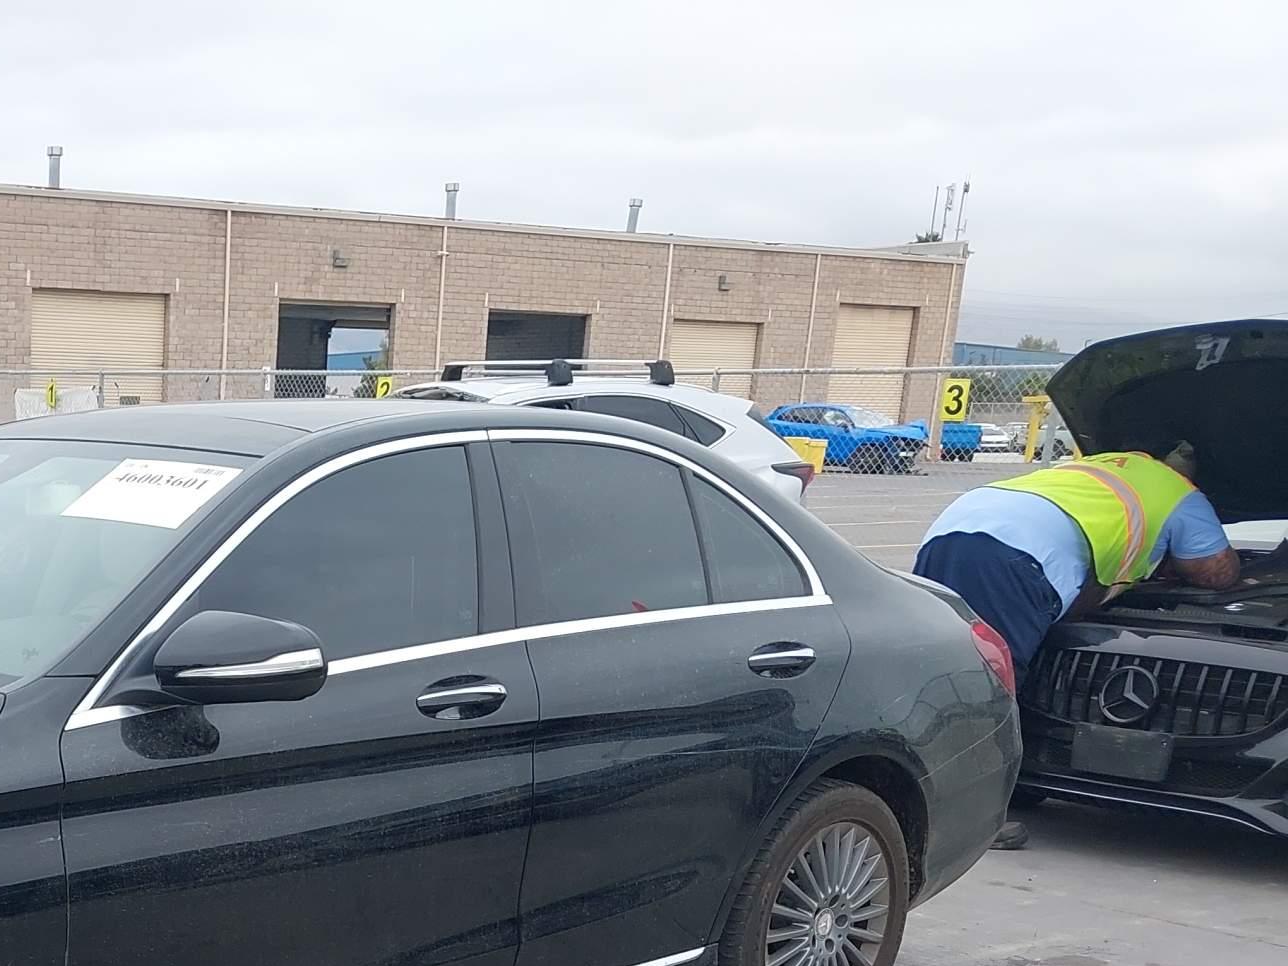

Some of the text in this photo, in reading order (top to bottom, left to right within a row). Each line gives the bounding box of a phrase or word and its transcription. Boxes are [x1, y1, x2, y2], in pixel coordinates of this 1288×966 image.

[48, 384, 54, 403] 1
[380, 381, 390, 398] 2
[944, 384, 964, 416] 3
[114, 472, 209, 490] 46003601
